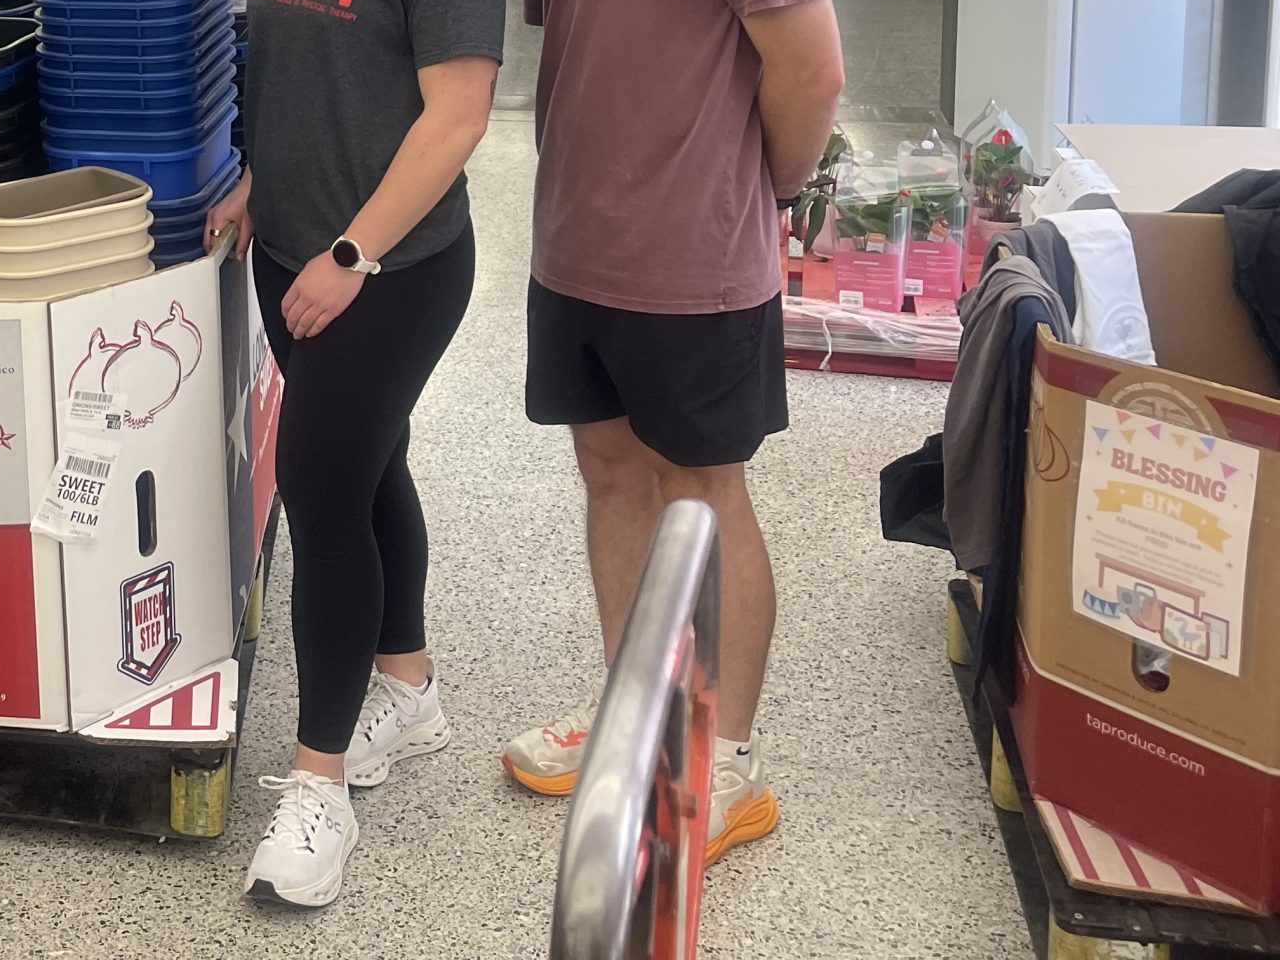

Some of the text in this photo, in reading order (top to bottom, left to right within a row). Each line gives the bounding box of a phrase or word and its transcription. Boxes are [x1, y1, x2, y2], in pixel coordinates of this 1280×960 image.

[58, 474, 106, 496] SWEET
[1110, 447, 1228, 503] BLESSING
[56, 488, 100, 506] 100/6LB
[1140, 491, 1184, 519] BIN
[70, 510, 99, 527] FILM
[134, 591, 166, 627] WATCH
[140, 620, 162, 653] STEP
[1086, 712, 1206, 777] taproduce.com
